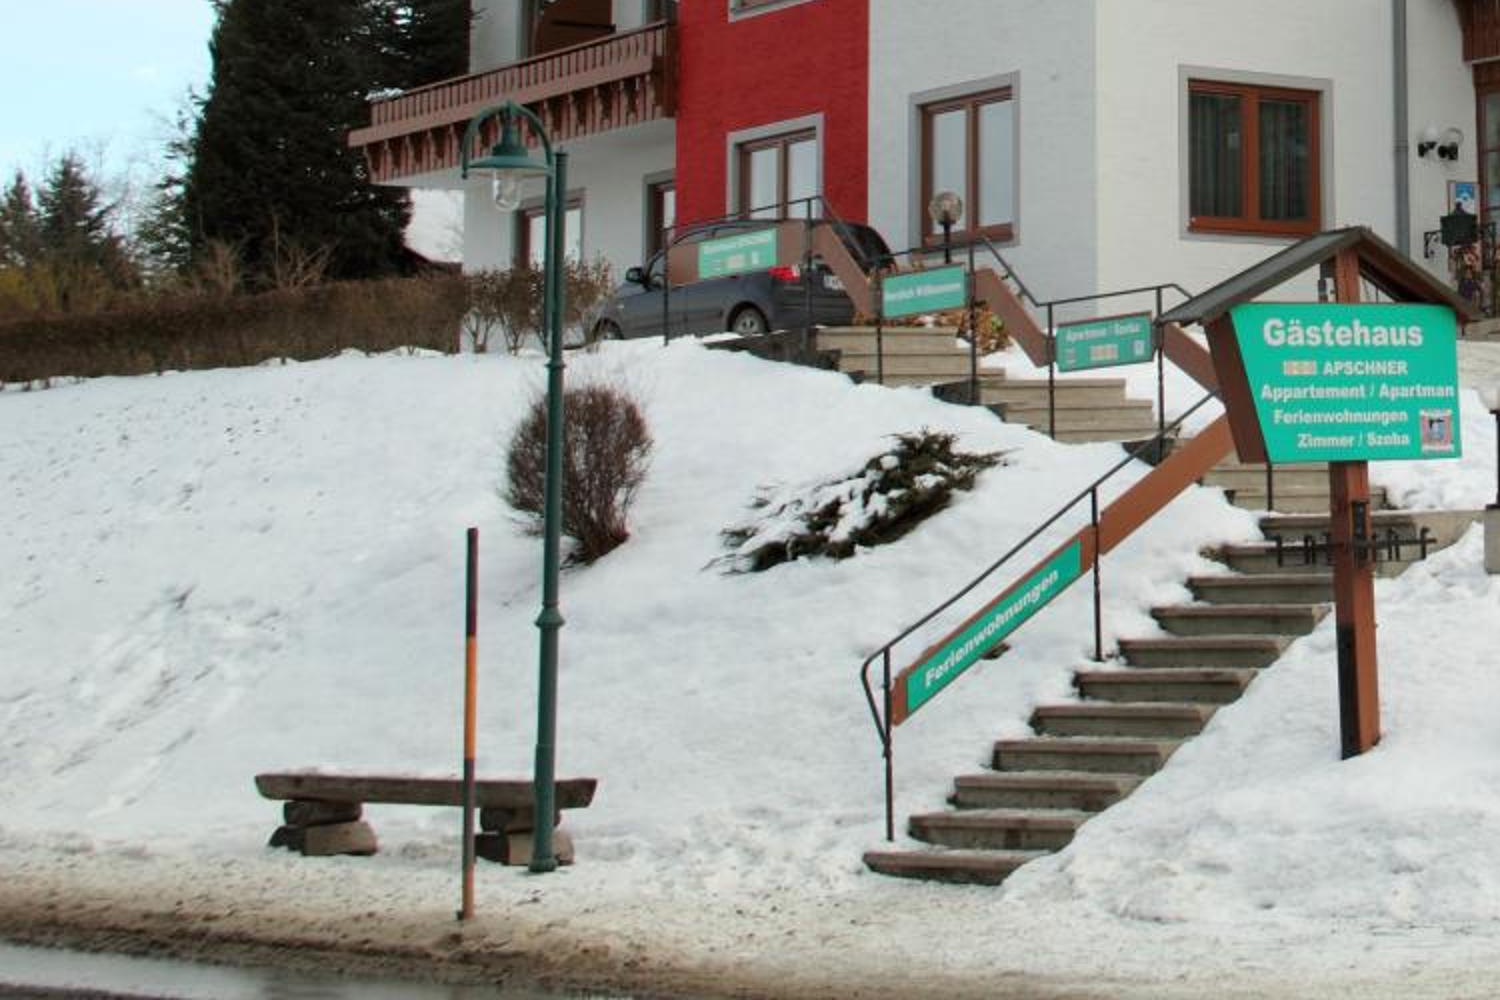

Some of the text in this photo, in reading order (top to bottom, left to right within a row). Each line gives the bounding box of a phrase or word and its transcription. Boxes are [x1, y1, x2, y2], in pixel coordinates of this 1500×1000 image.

[1263, 317, 1424, 347] Gästehaus
[1322, 360, 1408, 376] APSCHNER
[1261, 384, 1365, 402] Appartement
[1378, 384, 1455, 400] Apartman
[1273, 408, 1409, 426] Ferienwohnungen
[1297, 433, 1355, 449] Zimmer
[924, 569, 1060, 688] Ferienwohnungen
